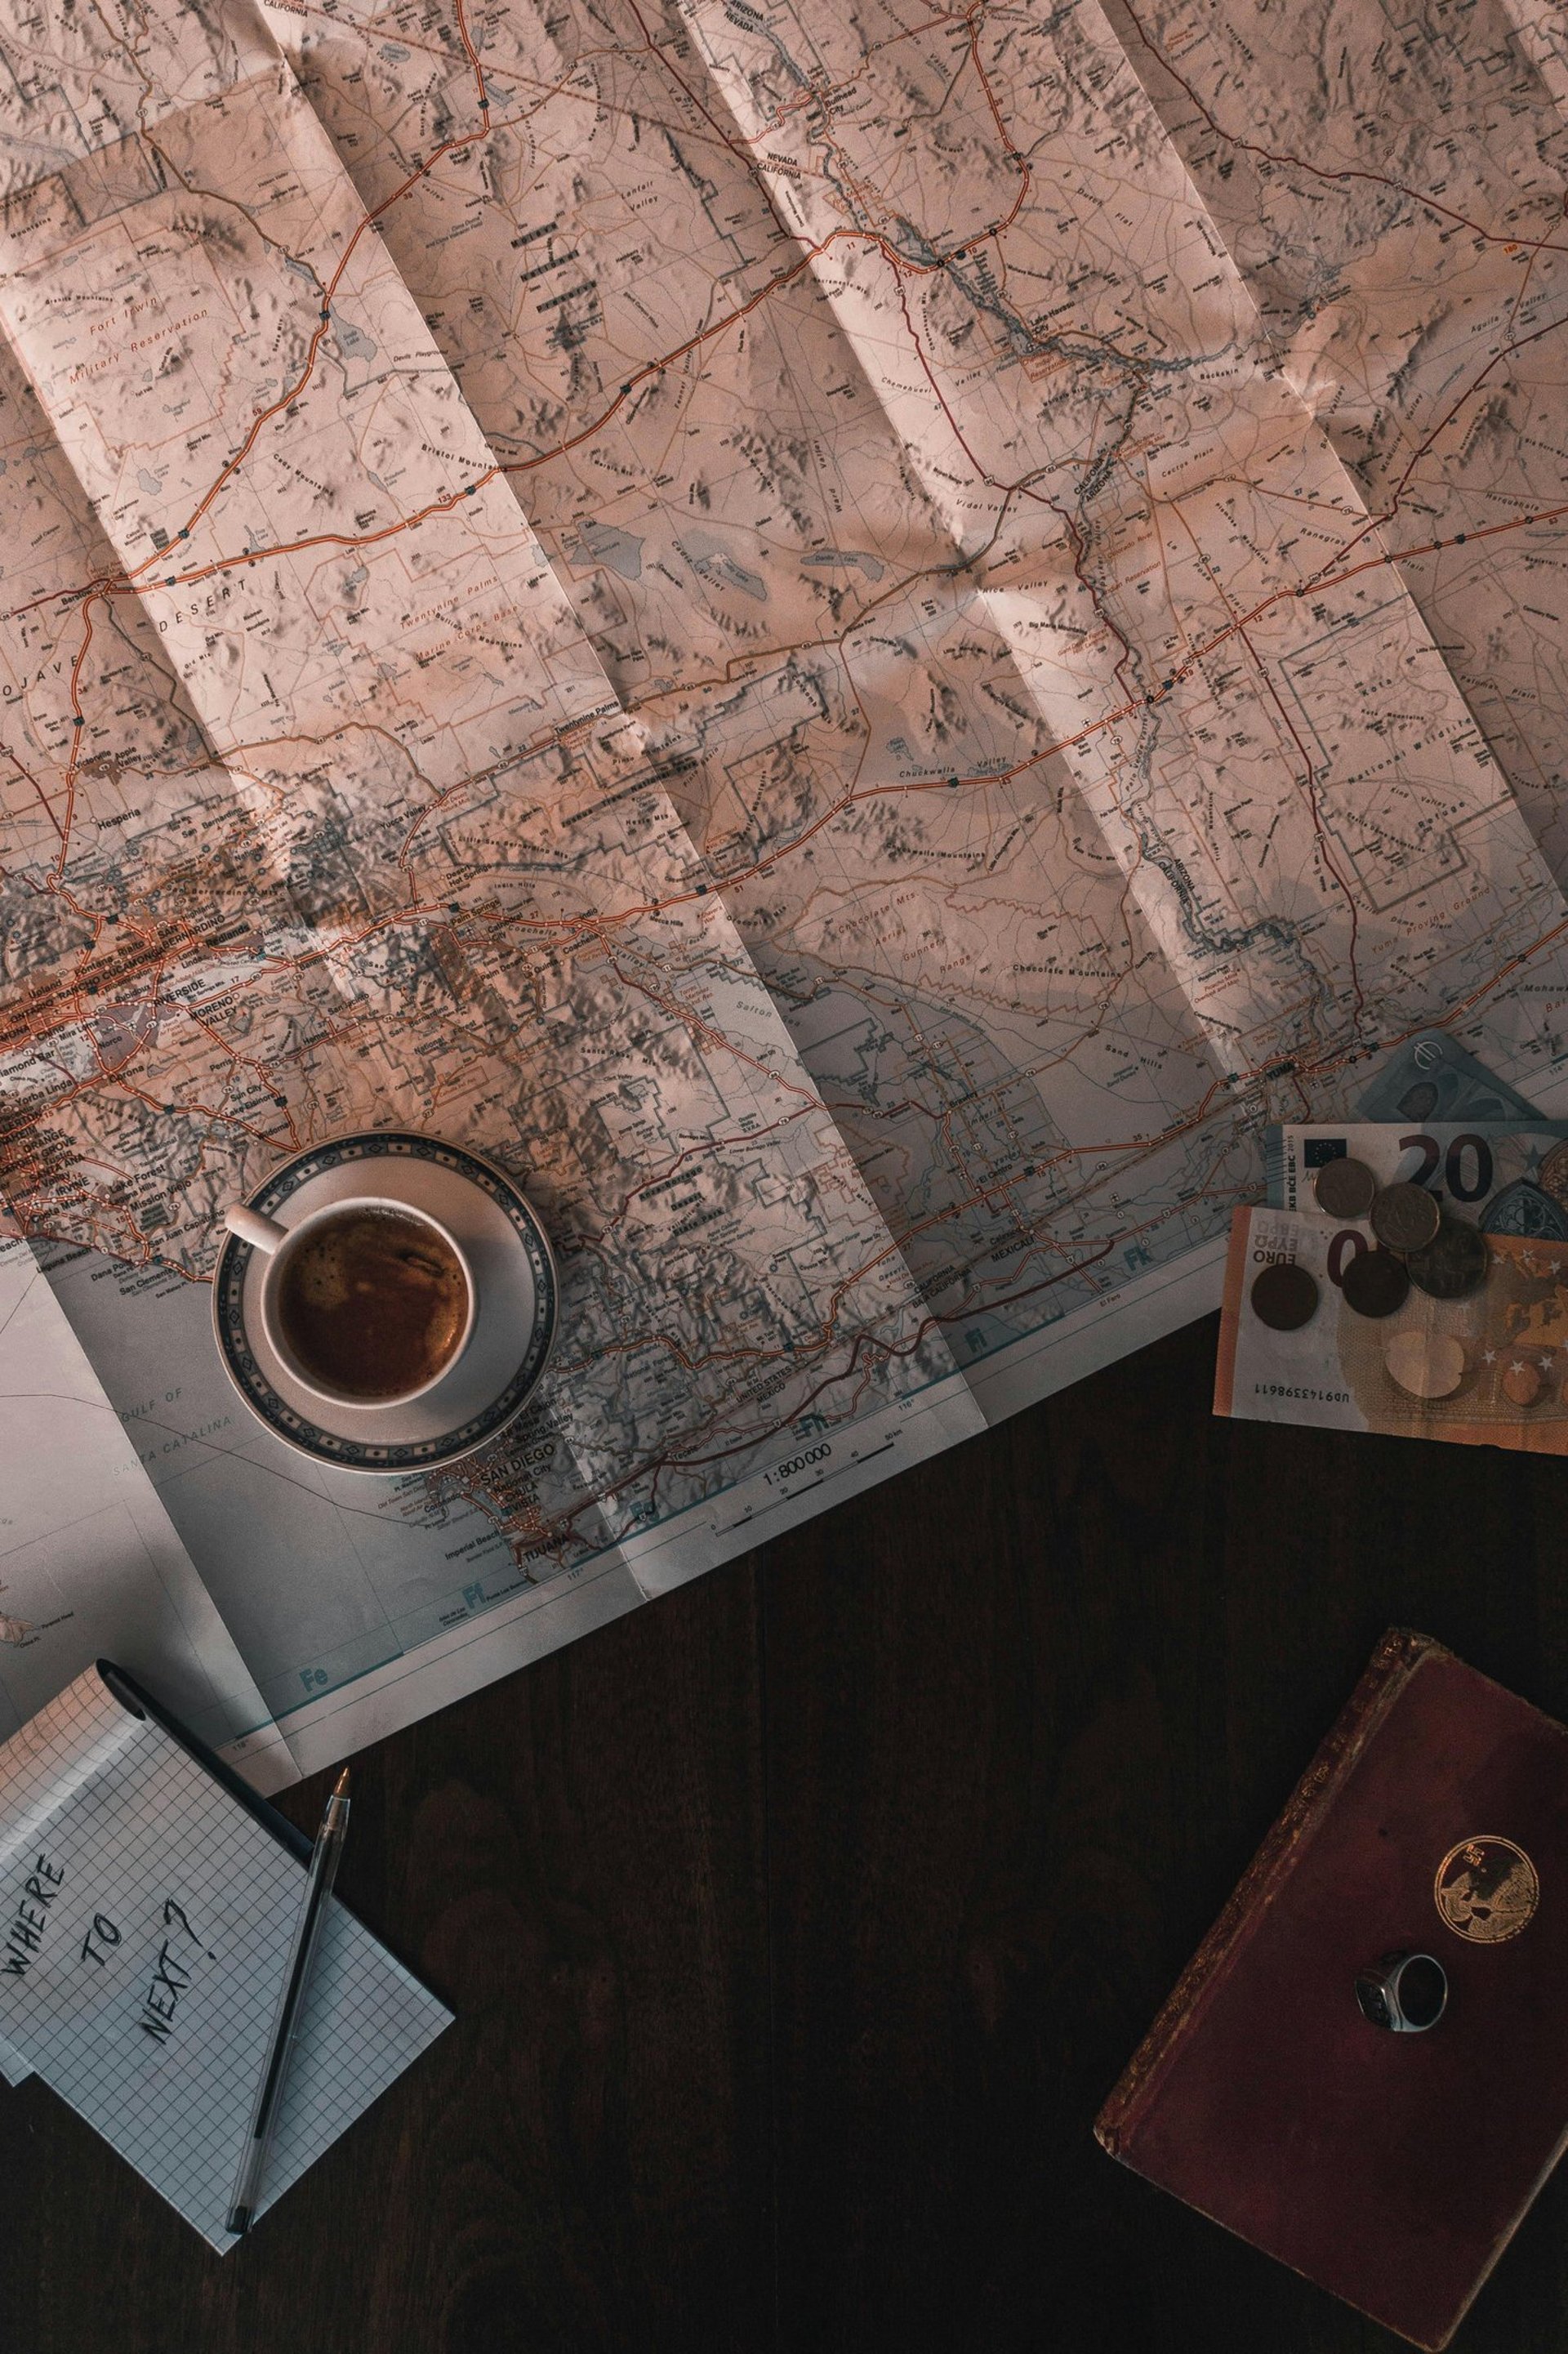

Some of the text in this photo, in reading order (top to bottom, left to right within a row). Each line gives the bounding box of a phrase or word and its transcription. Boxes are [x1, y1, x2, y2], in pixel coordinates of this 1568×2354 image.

[824, 86, 858, 107] Bullhead
[828, 103, 844, 116] City
[755, 163, 801, 179] CALIFORNIA
[766, 153, 798, 167] NEVADA
[629, 194, 659, 212] Valley
[519, 248, 580, 283] National
[87, 295, 158, 335] Fort Irwin
[1030, 300, 1076, 326] Lake Havasu
[128, 307, 210, 352] Reservation
[1034, 323, 1050, 336] City
[466, 574, 499, 595] Palms
[61, 586, 93, 607] Barstow
[591, 699, 619, 717] Palms
[74, 747, 112, 770] Victorville
[114, 744, 137, 761] Apple
[118, 752, 142, 769] Valley
[96, 805, 141, 834] Hesperia
[379, 802, 428, 831] Yucca Valley
[445, 864, 470, 881] Desert
[448, 862, 492, 888] Hot Springs
[1452, 885, 1492, 910] Ground
[449, 897, 501, 926] Palm Springs
[486, 911, 524, 934] Cathedral
[577, 907, 599, 921] Indio
[837, 903, 891, 934] Chocolate
[157, 924, 178, 939] SAN
[161, 913, 226, 950] BERNARDINO
[205, 921, 251, 949] Redlands
[257, 919, 290, 939] Yucaipa
[491, 929, 507, 942] City
[873, 925, 907, 946] Aerial
[561, 931, 599, 955] Coachella
[902, 934, 949, 963] Gunnery
[298, 952, 331, 972] Banning
[479, 955, 525, 982] Palm Desert
[532, 957, 559, 975] Quinta
[938, 953, 971, 974] Range
[27, 978, 63, 1001] Upland
[57, 974, 102, 1001] RANCHO
[153, 978, 207, 1009] RIVERSIDE
[189, 994, 234, 1022] MORENO
[36, 1023, 65, 1042] Chino
[98, 1033, 122, 1050] Norco
[302, 1028, 328, 1046] Hemet
[109, 1062, 145, 1086] Corona
[208, 1055, 234, 1073] Perris
[1266, 1061, 1295, 1081] YUMA
[14, 1086, 47, 1109] Yorba
[229, 1081, 263, 1103] Sun City
[949, 1089, 978, 1108] Brawley
[22, 1128, 66, 1154] ORANGE
[40, 1135, 77, 1158] GROVE
[28, 1152, 85, 1184] SANTA ANA
[42, 1148, 73, 1168] Tustin
[1288, 1155, 1296, 1173] EBC
[1399, 1133, 1494, 1203] 20
[109, 1162, 165, 1195] Lake Forest
[986, 1162, 1013, 1179] Centro
[55, 1175, 91, 1198] IRVINE
[129, 1177, 193, 1213] Mission Viejo
[29, 1205, 60, 1225] Costa
[148, 1227, 184, 1249] San Juan
[990, 1235, 1036, 1263] MEXICALI
[1254, 1251, 1296, 1265] EURO
[90, 1266, 112, 1282] Dana
[163, 1386, 185, 1403] OF
[734, 1365, 793, 1402] UNITED STATES
[755, 1382, 787, 1403] MEXICO
[1254, 1384, 1350, 1403] UD9143398611
[479, 1442, 556, 1487] SAN DIEGO
[423, 1491, 461, 1514] Coronado
[443, 1528, 500, 1561] Imperial Beach
[522, 1532, 570, 1563] TIJUANA
[297, 1662, 330, 1692] Fe
[1, 1853, 65, 1976] WHERE
[81, 1912, 122, 1966] TO
[139, 1897, 216, 2044] NEXT?
